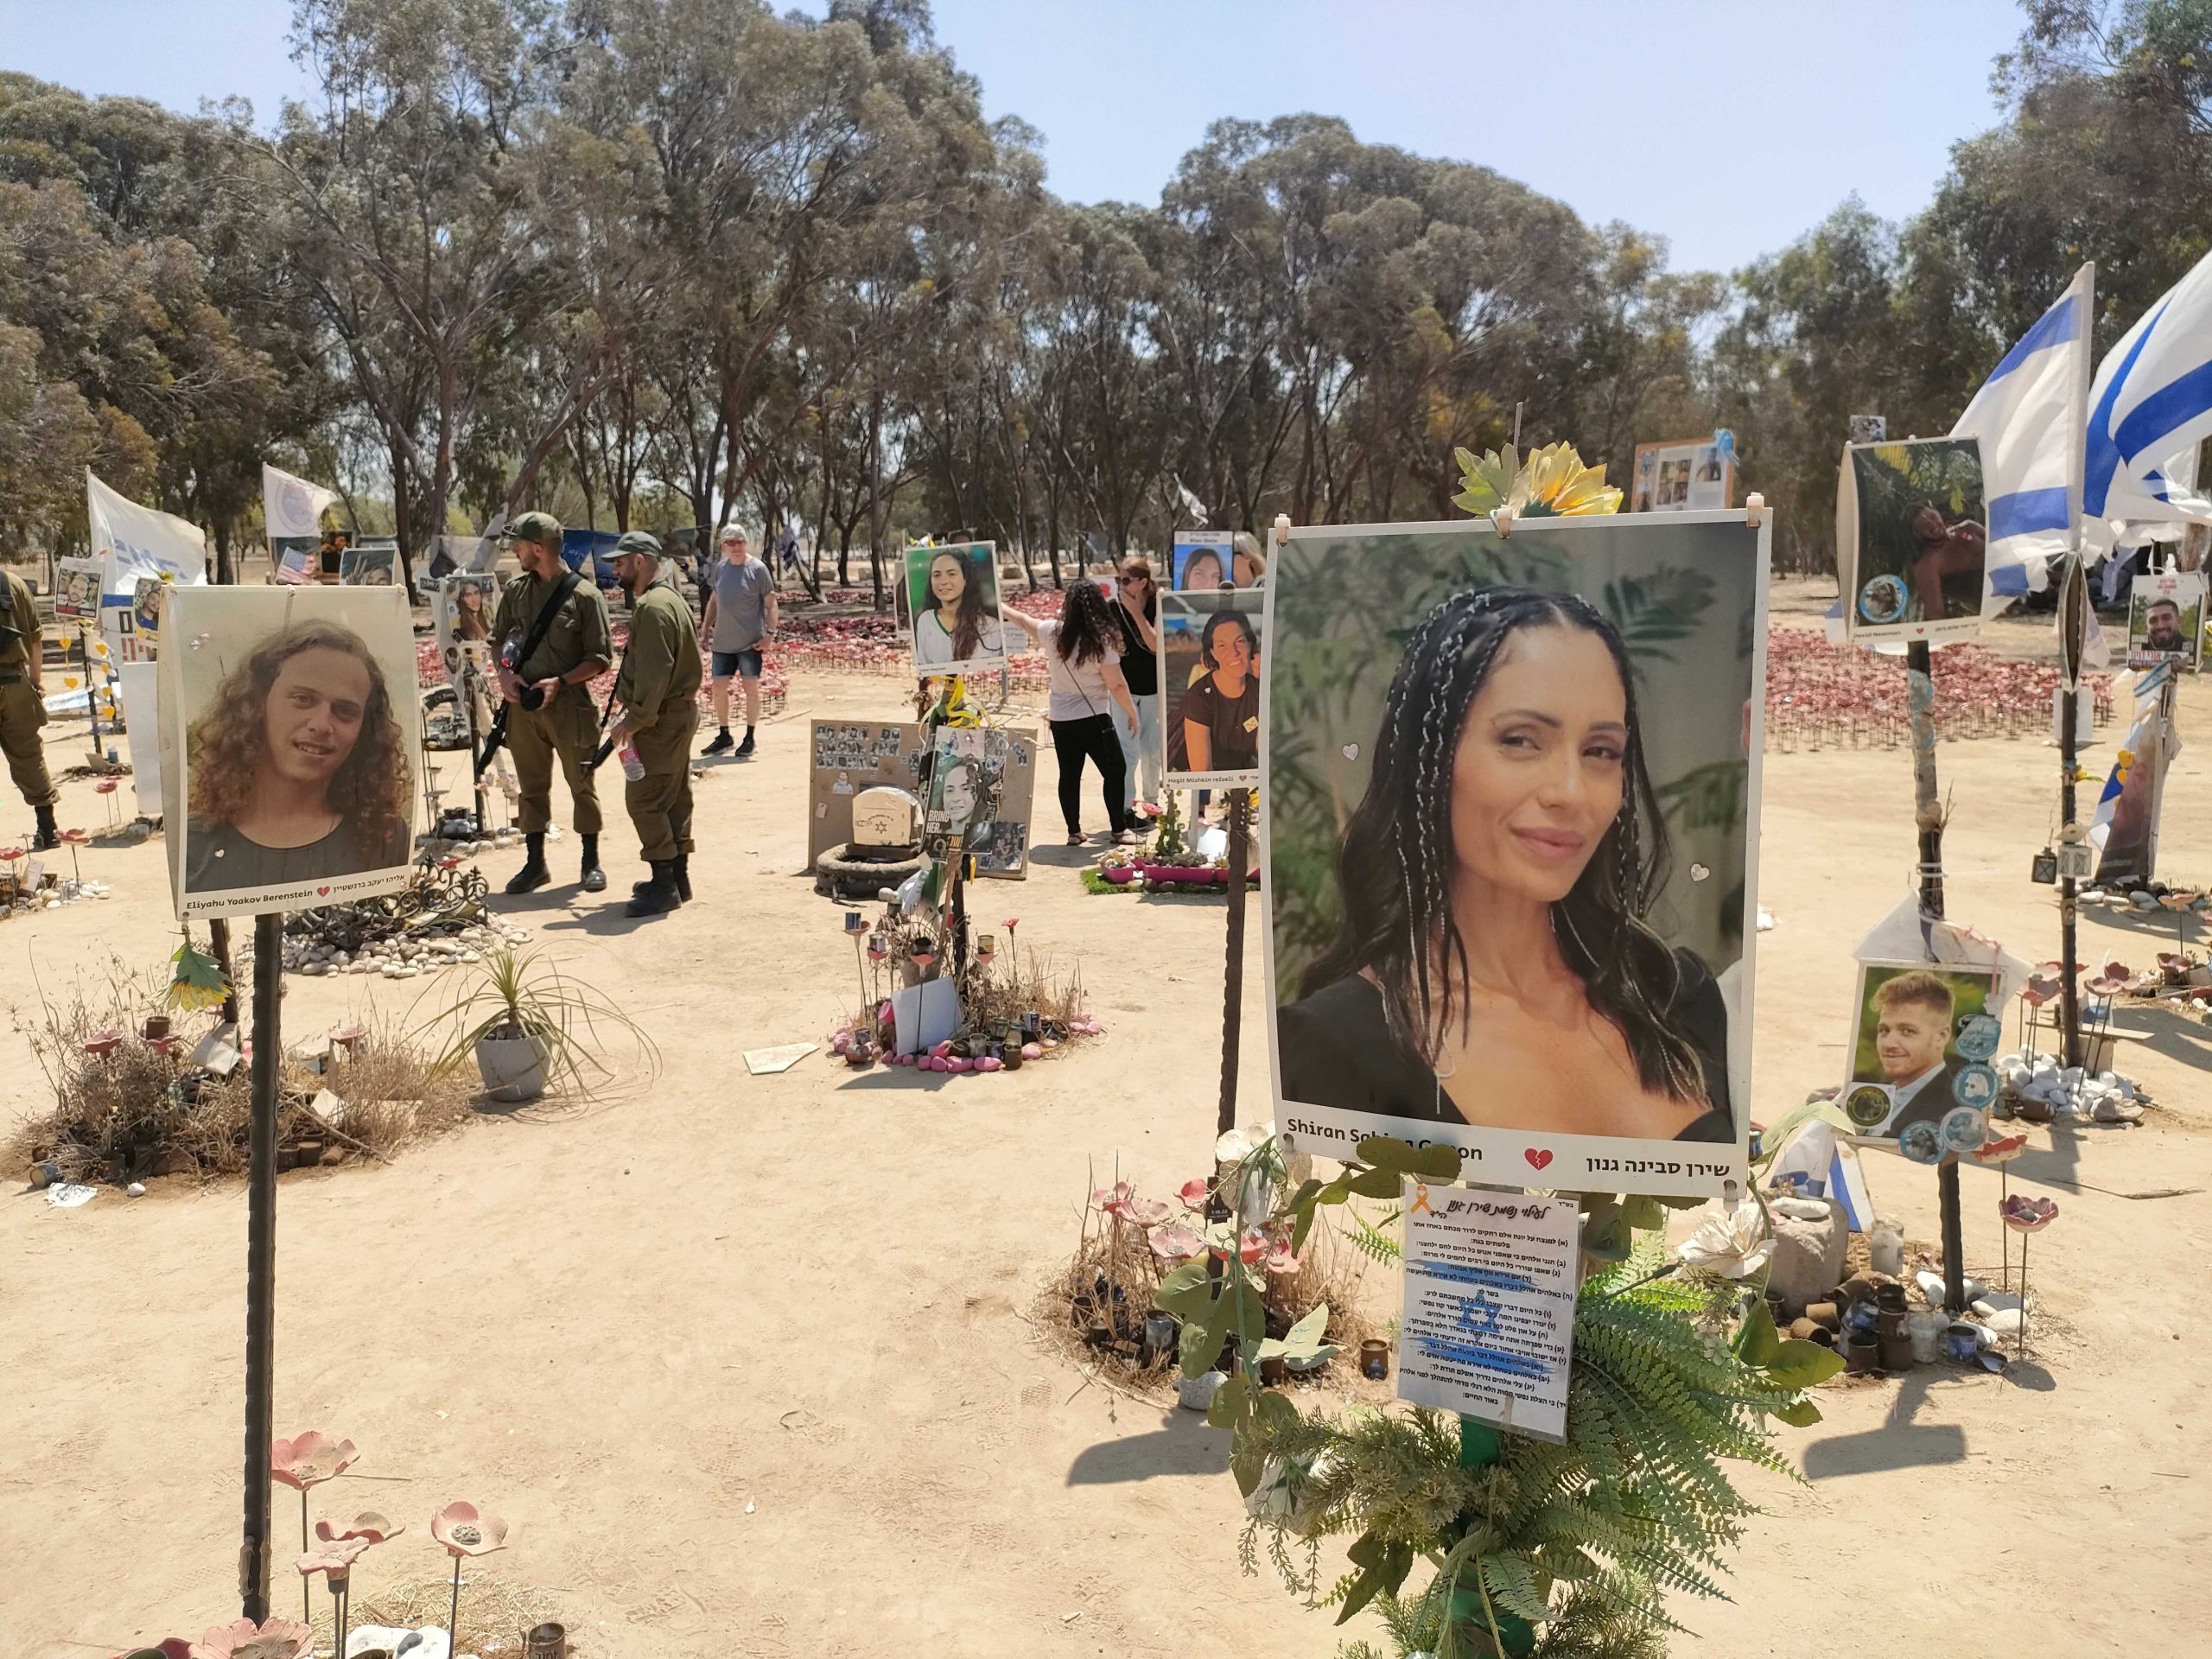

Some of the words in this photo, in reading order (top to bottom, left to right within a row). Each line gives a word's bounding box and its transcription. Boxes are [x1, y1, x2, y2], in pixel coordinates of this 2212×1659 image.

[928, 810, 950, 822] BRING
[367, 878, 385, 887] יעקב
[386, 874, 405, 883] אליהו
[334, 882, 365, 893] ברנשטיין
[187, 899, 225, 910] Eliyahu
[226, 896, 262, 906] Yaakov
[264, 889, 313, 902] Berenstein
[1287, 1118, 1345, 1141] Shiran
[1586, 1158, 1619, 1173] גנון
[1624, 1160, 1681, 1174] סבינה
[1687, 1163, 1730, 1178] שירן
[1447, 1199, 1465, 1213] גנון
[1467, 1202, 1491, 1214] שירן
[1489, 1205, 1517, 1219] נשמת
[1522, 1205, 1551, 1219] לעילוי
